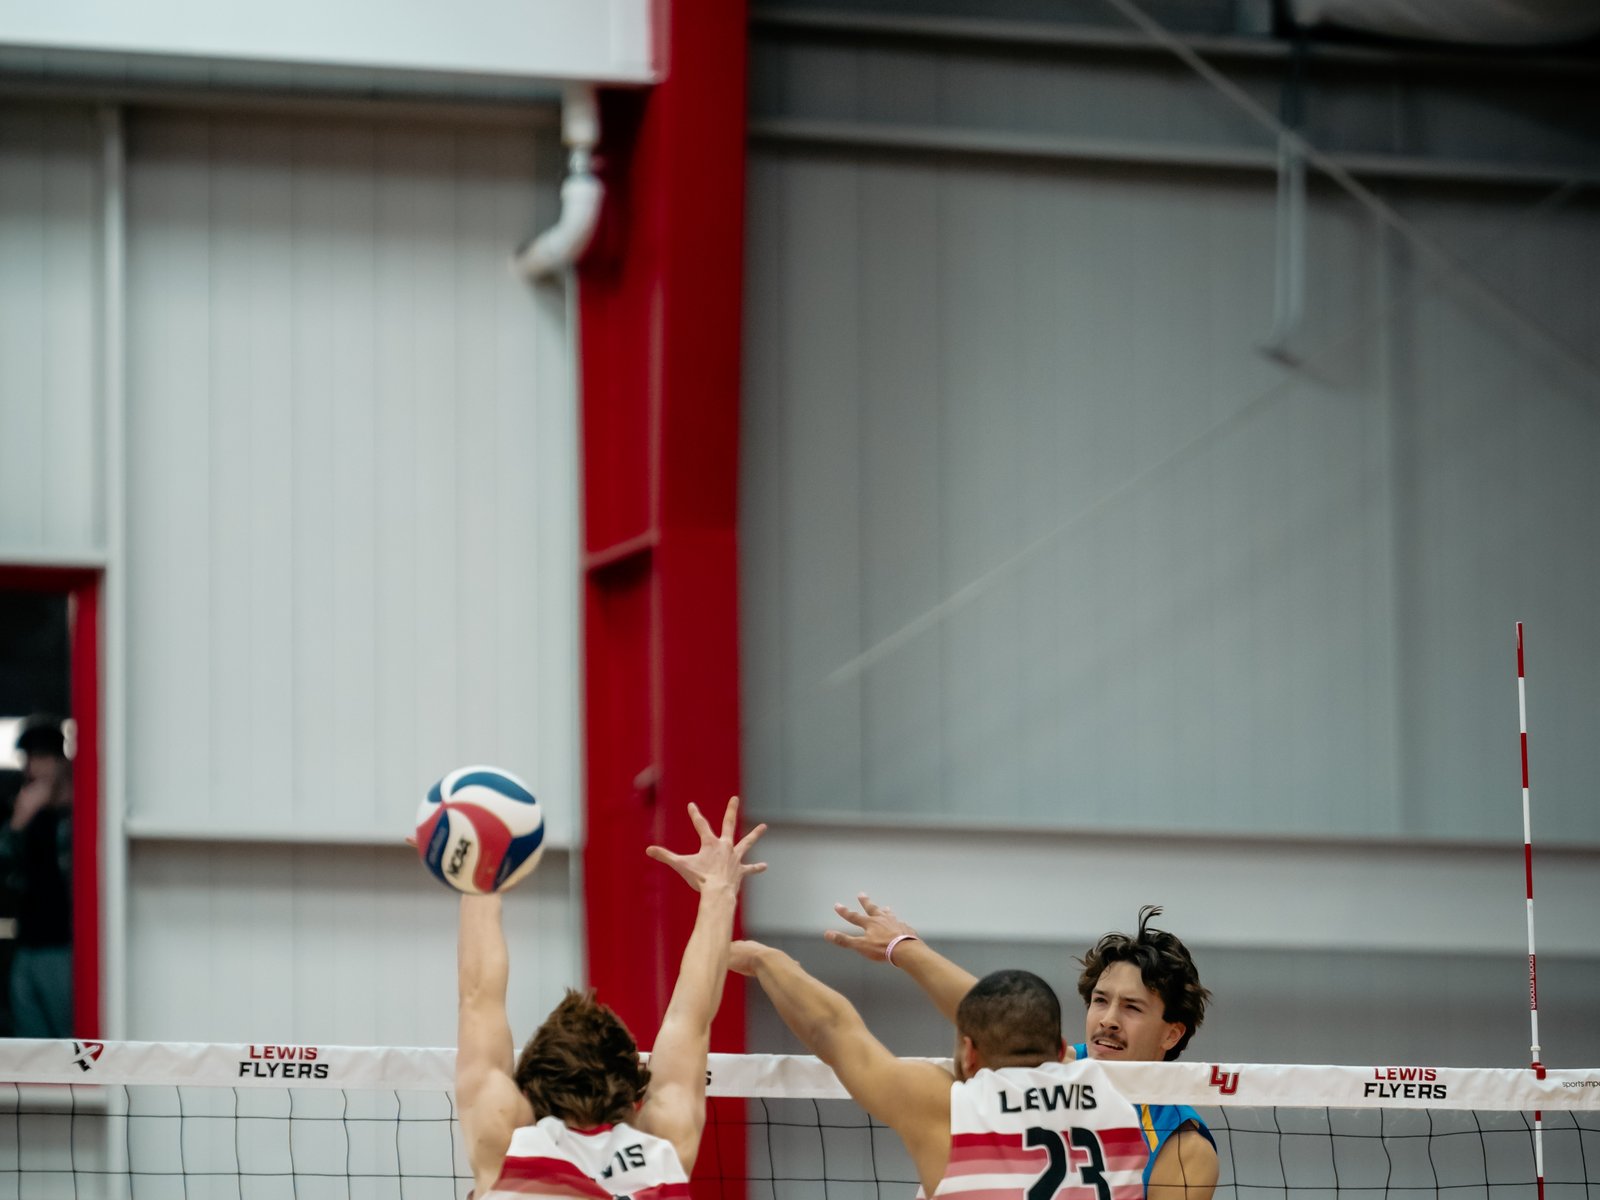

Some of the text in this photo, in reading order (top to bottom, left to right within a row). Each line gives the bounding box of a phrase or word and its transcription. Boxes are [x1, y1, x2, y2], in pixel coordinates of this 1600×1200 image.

[249, 1045, 318, 1060] LEWIS
[239, 1061, 329, 1079] FLYERS
[1374, 1068, 1436, 1082] LEWIS
[998, 1084, 1098, 1114] LEWIS
[1363, 1082, 1447, 1099] FLYERS
